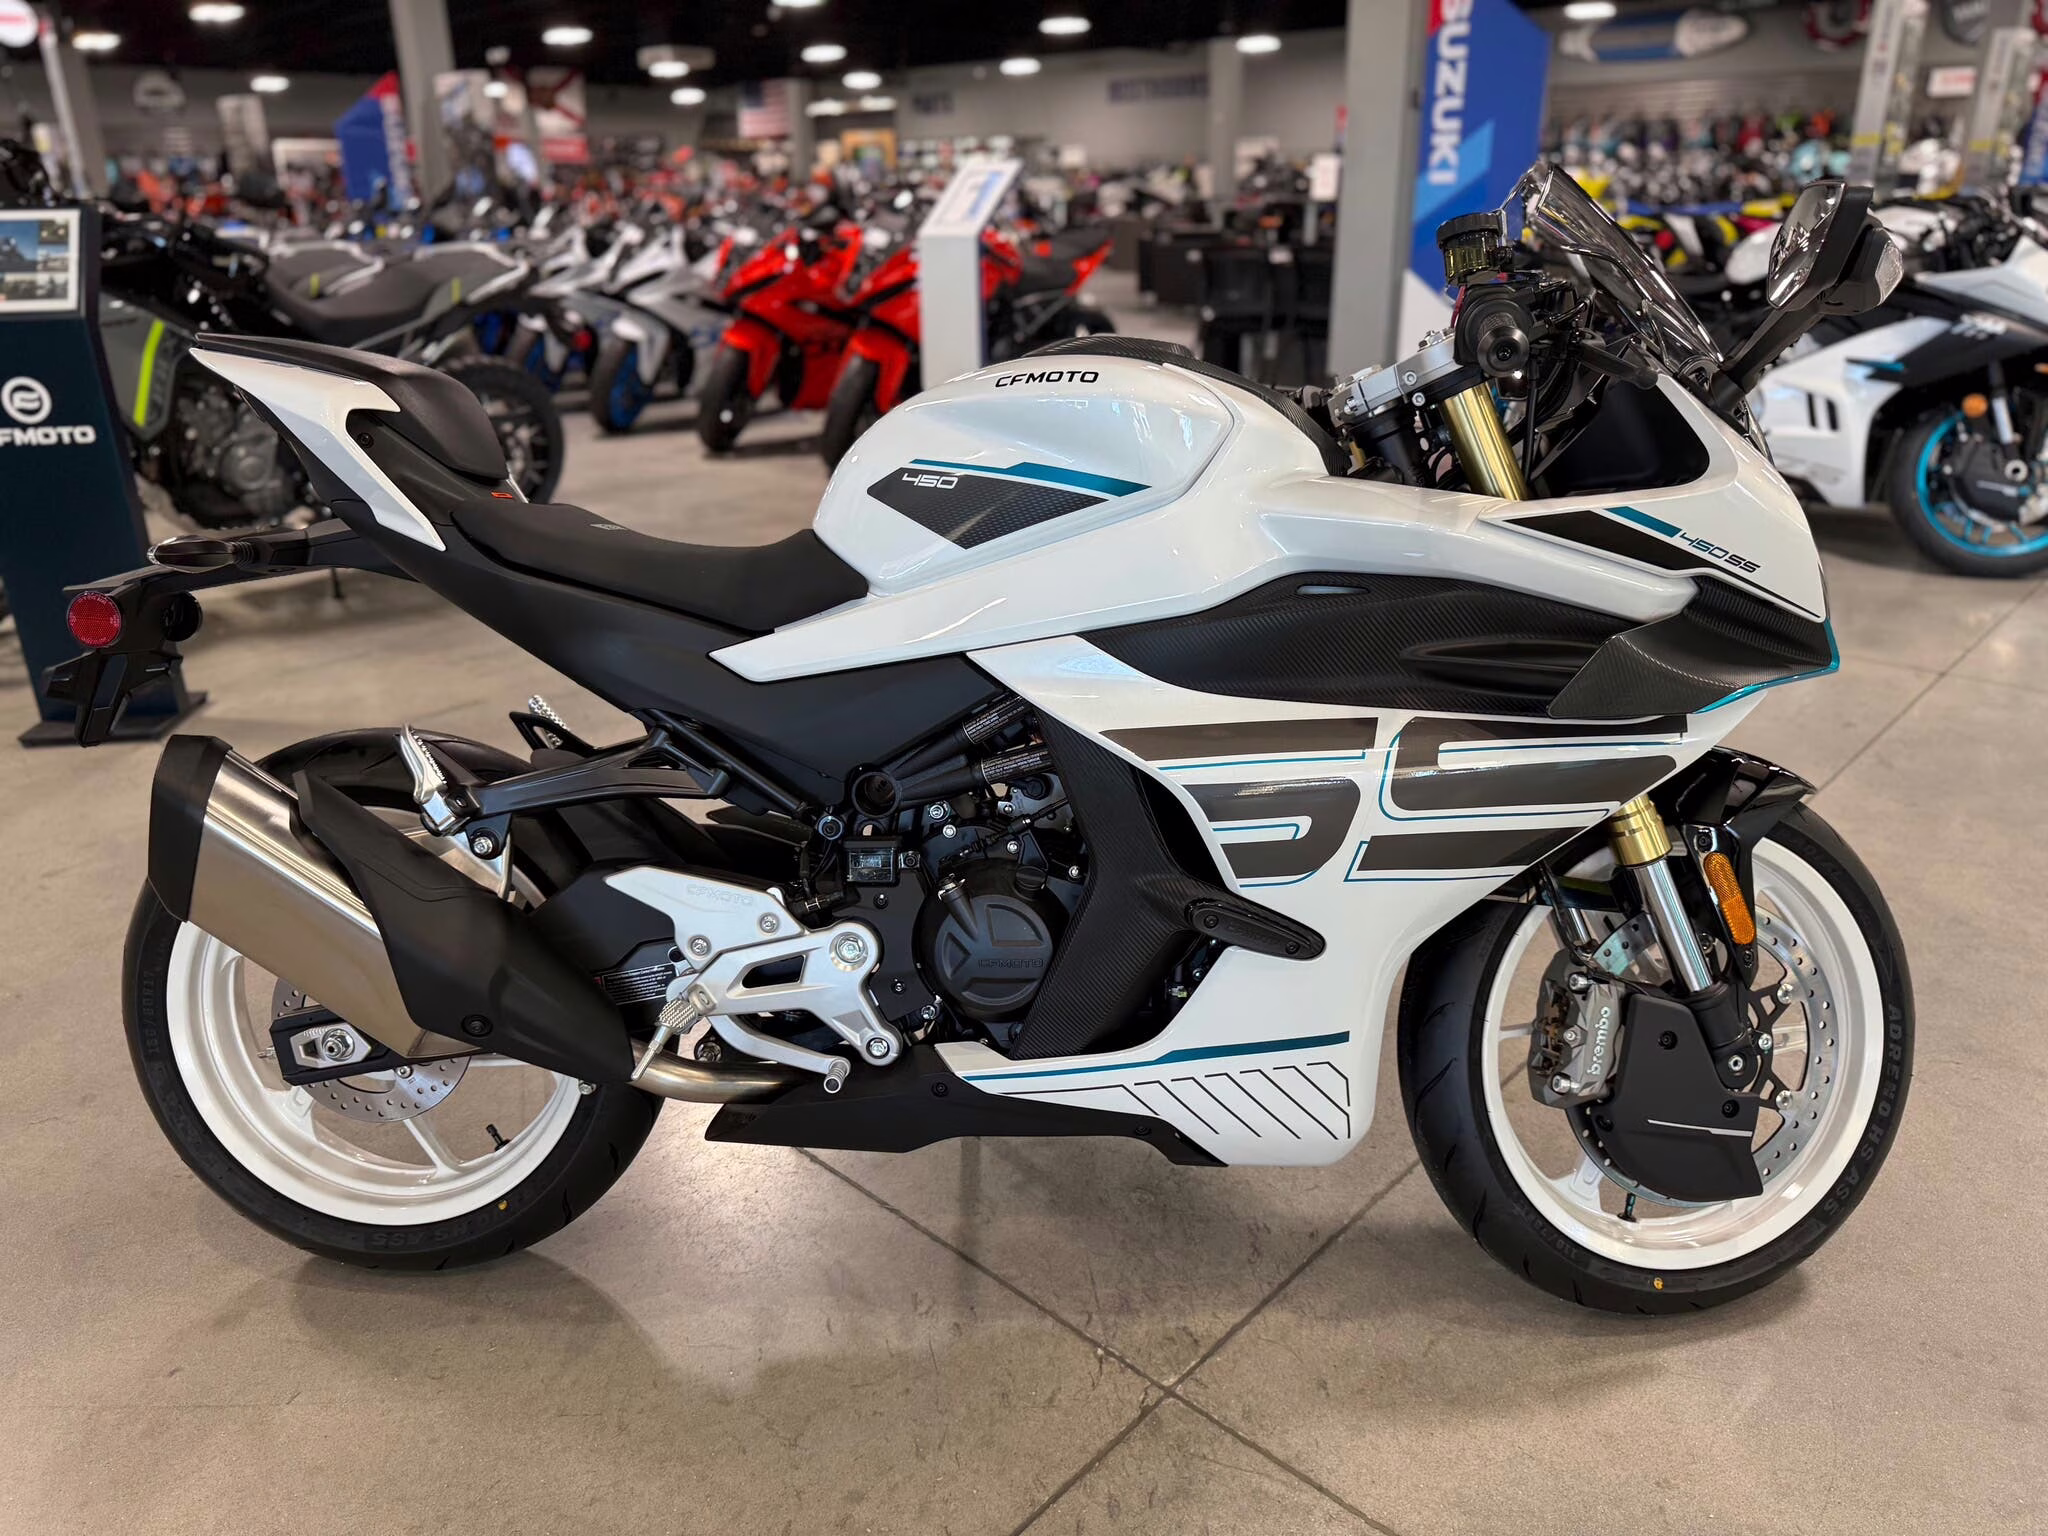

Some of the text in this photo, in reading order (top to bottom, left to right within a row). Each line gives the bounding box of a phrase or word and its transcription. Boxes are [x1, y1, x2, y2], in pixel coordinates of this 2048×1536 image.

[1427, 0, 1474, 185] SUZUKI
[995, 370, 1100, 388] CFMOTO
[0, 424, 97, 447] FMOTO
[902, 472, 959, 490] 450
[1679, 531, 1761, 573] 450SS
[1586, 1006, 1612, 1076] brembo
[1877, 1005, 1905, 1118] ADRENO
[1860, 1123, 1886, 1162] HS
